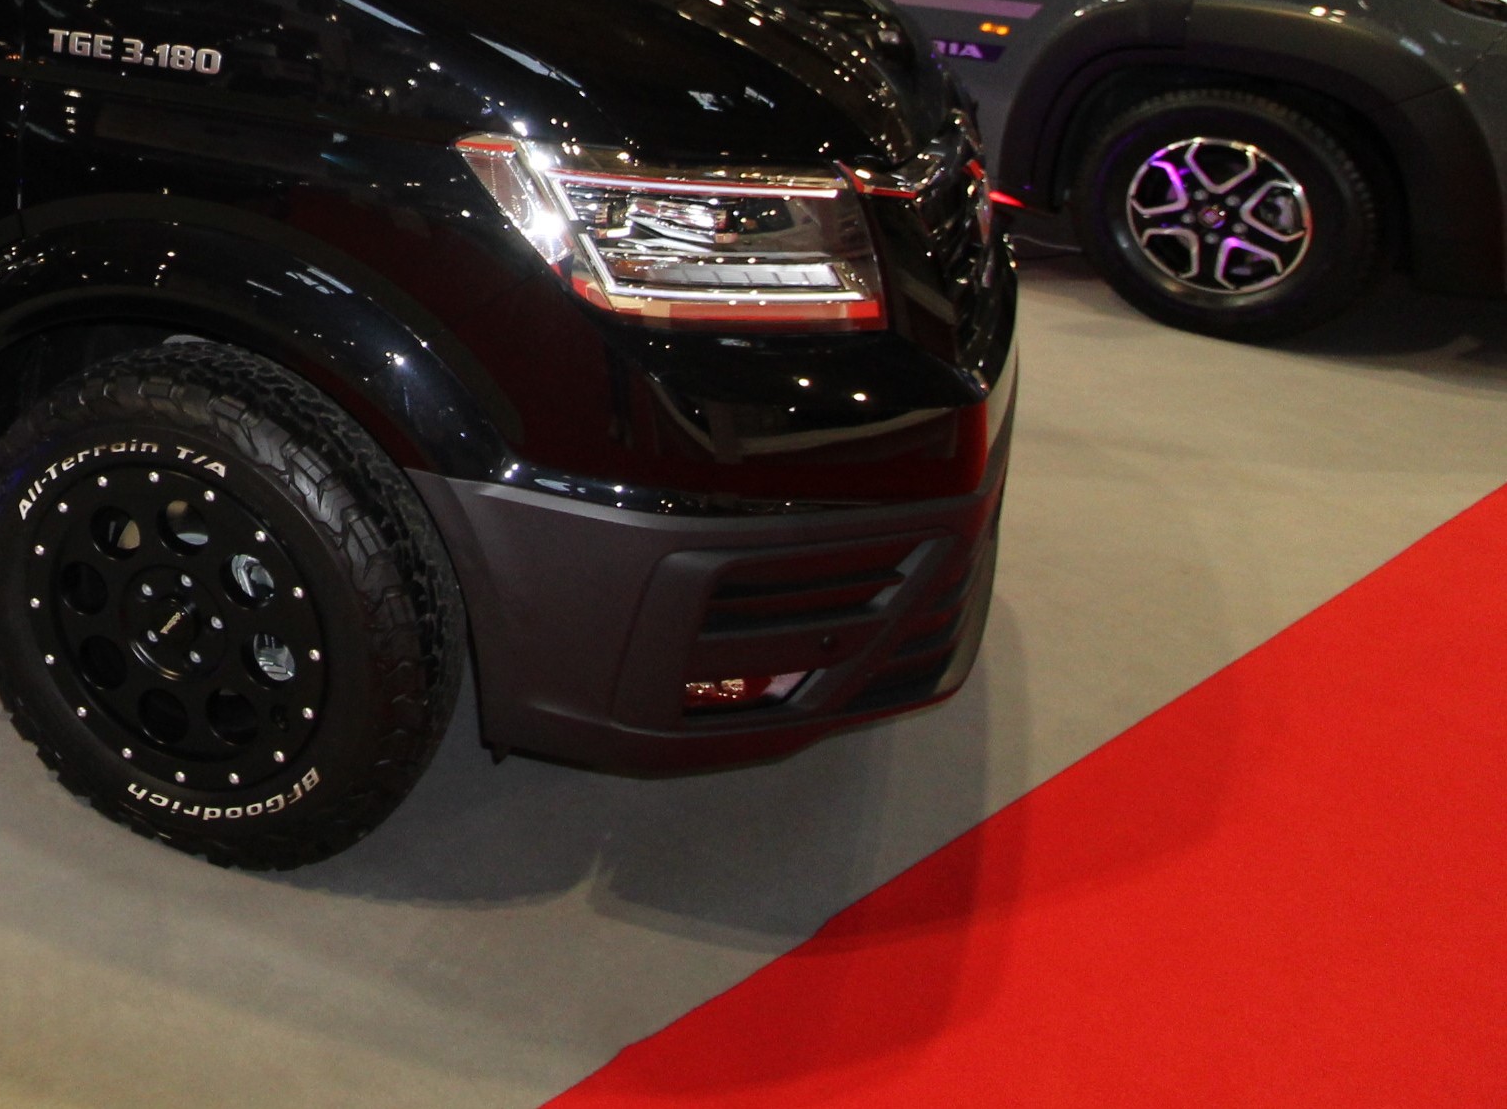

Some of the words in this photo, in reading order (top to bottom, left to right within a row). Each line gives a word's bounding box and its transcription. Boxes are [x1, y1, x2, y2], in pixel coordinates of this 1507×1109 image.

[48, 28, 114, 60] TGE
[121, 37, 222, 75] 3.180
[18, 439, 158, 520] All-Terrain
[176, 445, 227, 478] T/A
[127, 766, 321, 821] BFGoodrich
